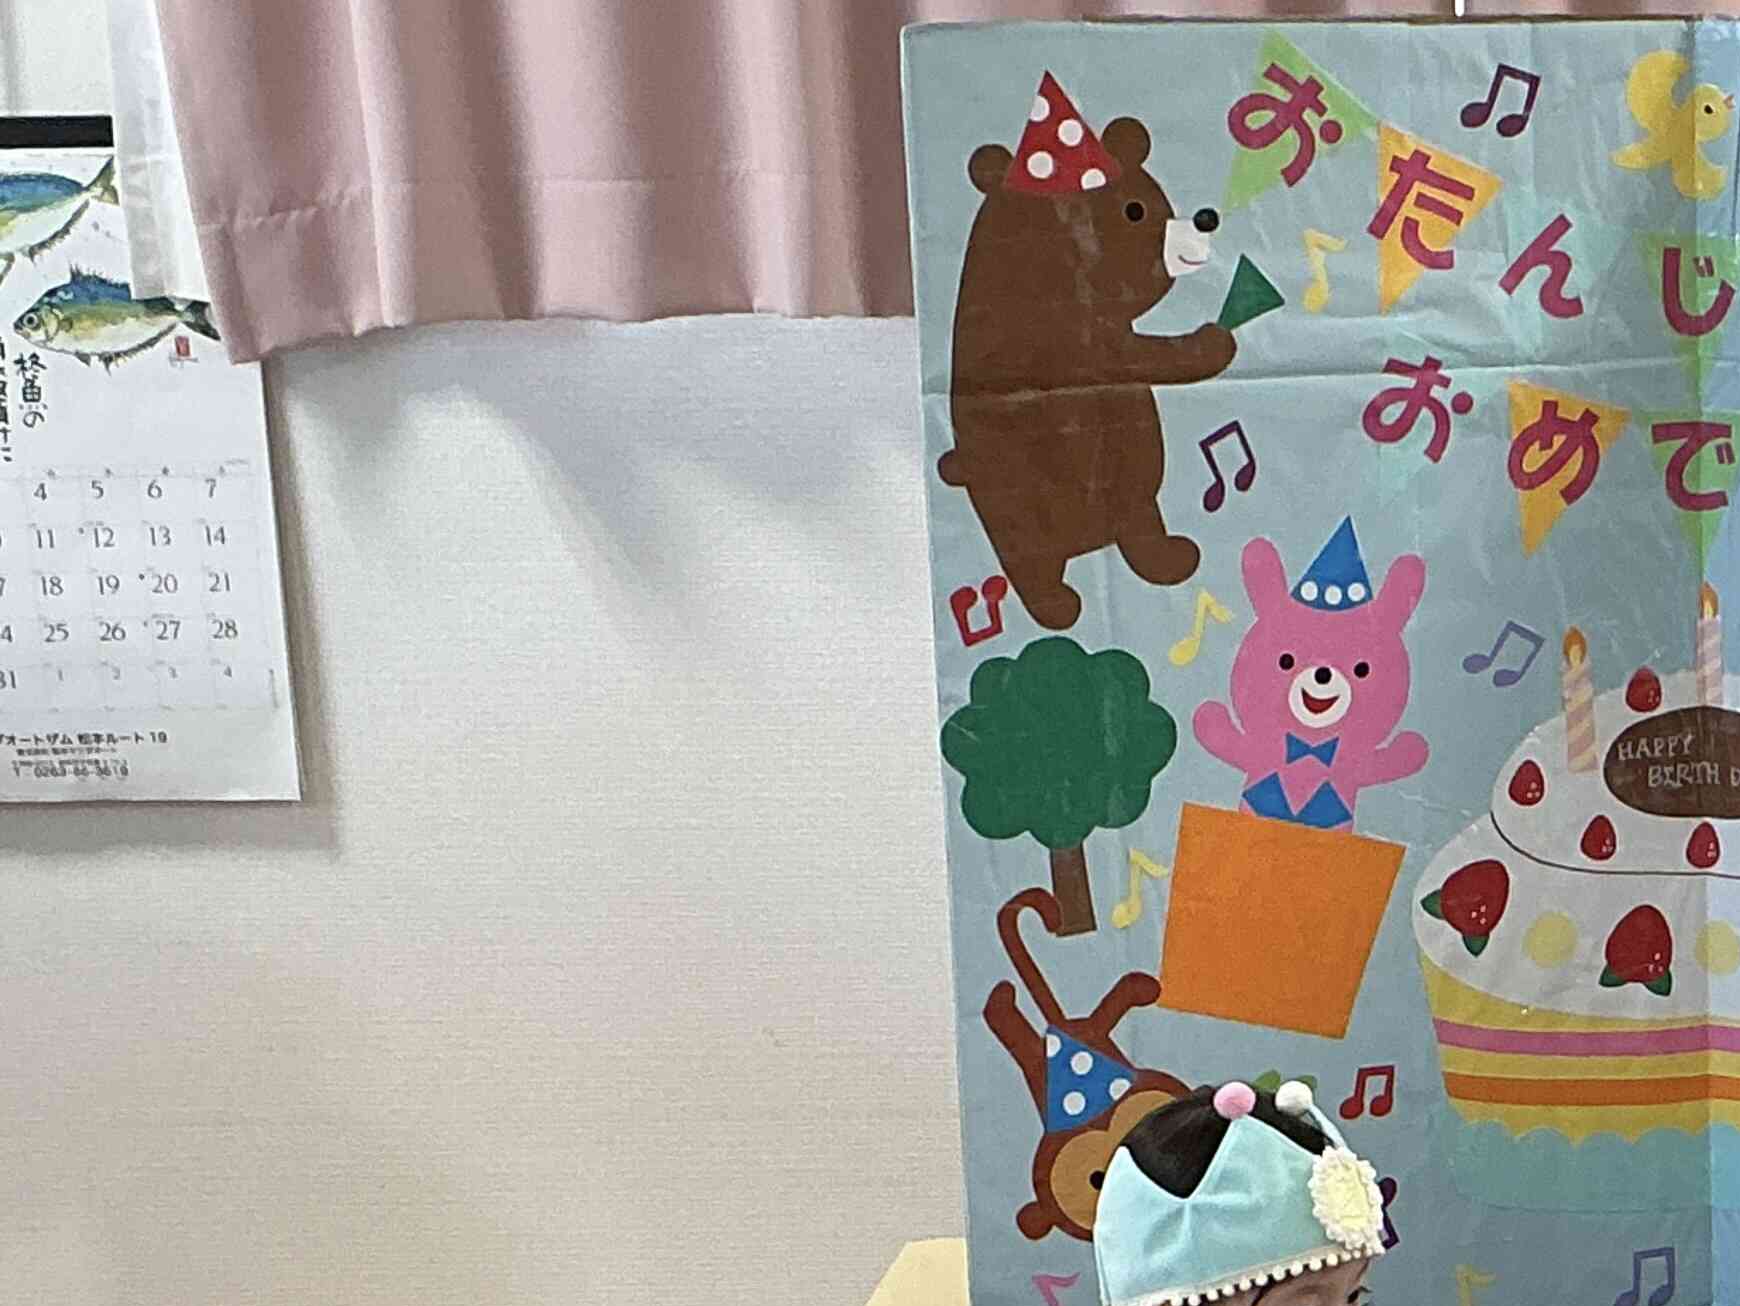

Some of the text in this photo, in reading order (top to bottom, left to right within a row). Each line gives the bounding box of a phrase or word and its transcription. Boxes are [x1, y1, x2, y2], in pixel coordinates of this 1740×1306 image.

[33, 478, 217, 501] 4 5 6 7
[35, 525, 227, 549] 11 12 13 14
[41, 572, 231, 597] 18 19 20 21
[44, 623, 70, 643] 25
[98, 621, 127, 642] 26
[155, 620, 181, 641] 27
[211, 619, 239, 640] 28
[1616, 734, 1694, 761] HAPPY
[1647, 760, 1721, 789] BIRTH
